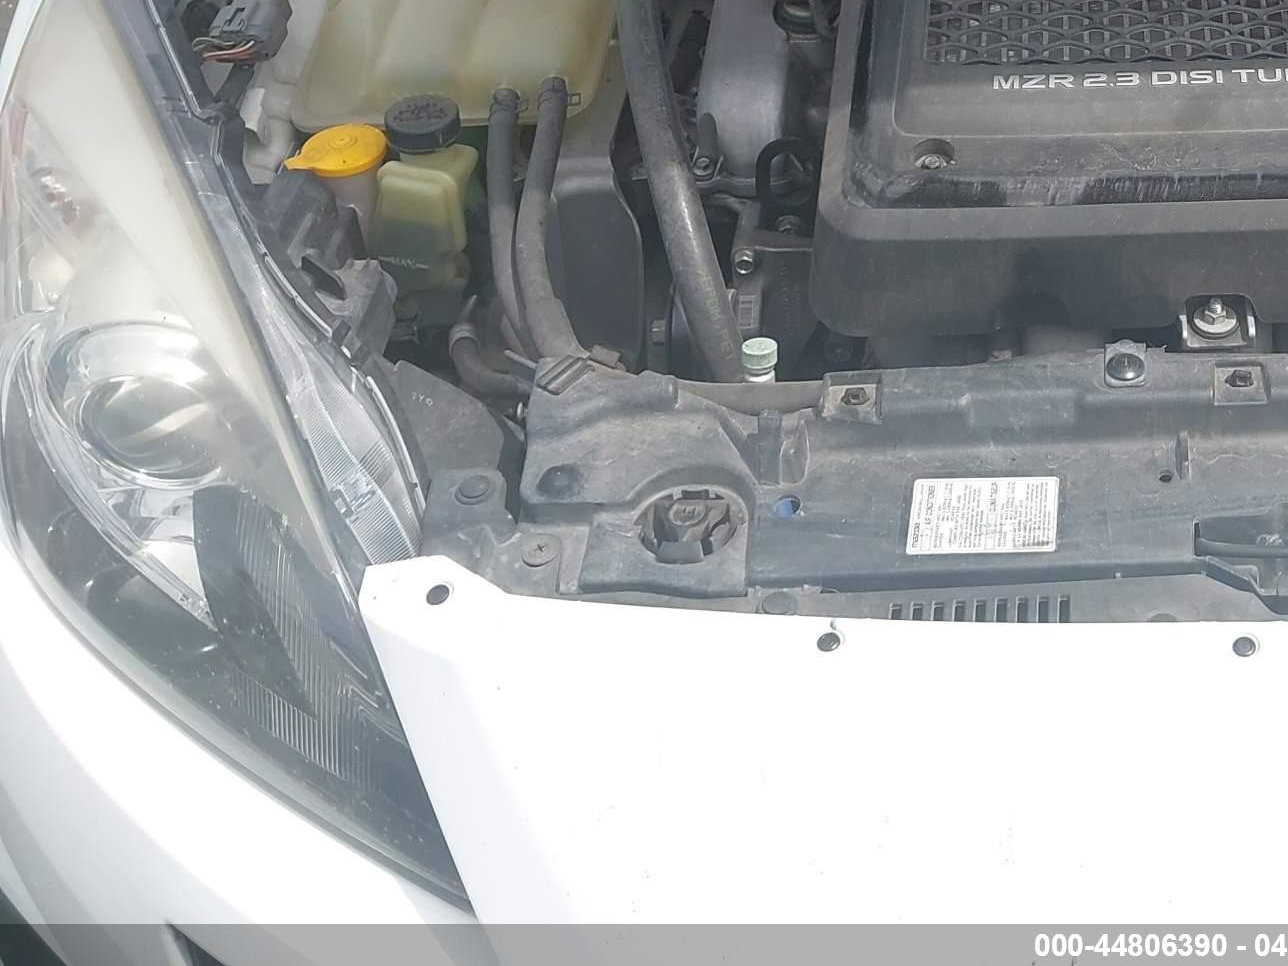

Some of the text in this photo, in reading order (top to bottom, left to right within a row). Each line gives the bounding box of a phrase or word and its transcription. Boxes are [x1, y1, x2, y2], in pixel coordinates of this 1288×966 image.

[992, 72, 1075, 91] MZR
[1082, 71, 1142, 89] 2.3
[1150, 68, 1225, 87] DISI
